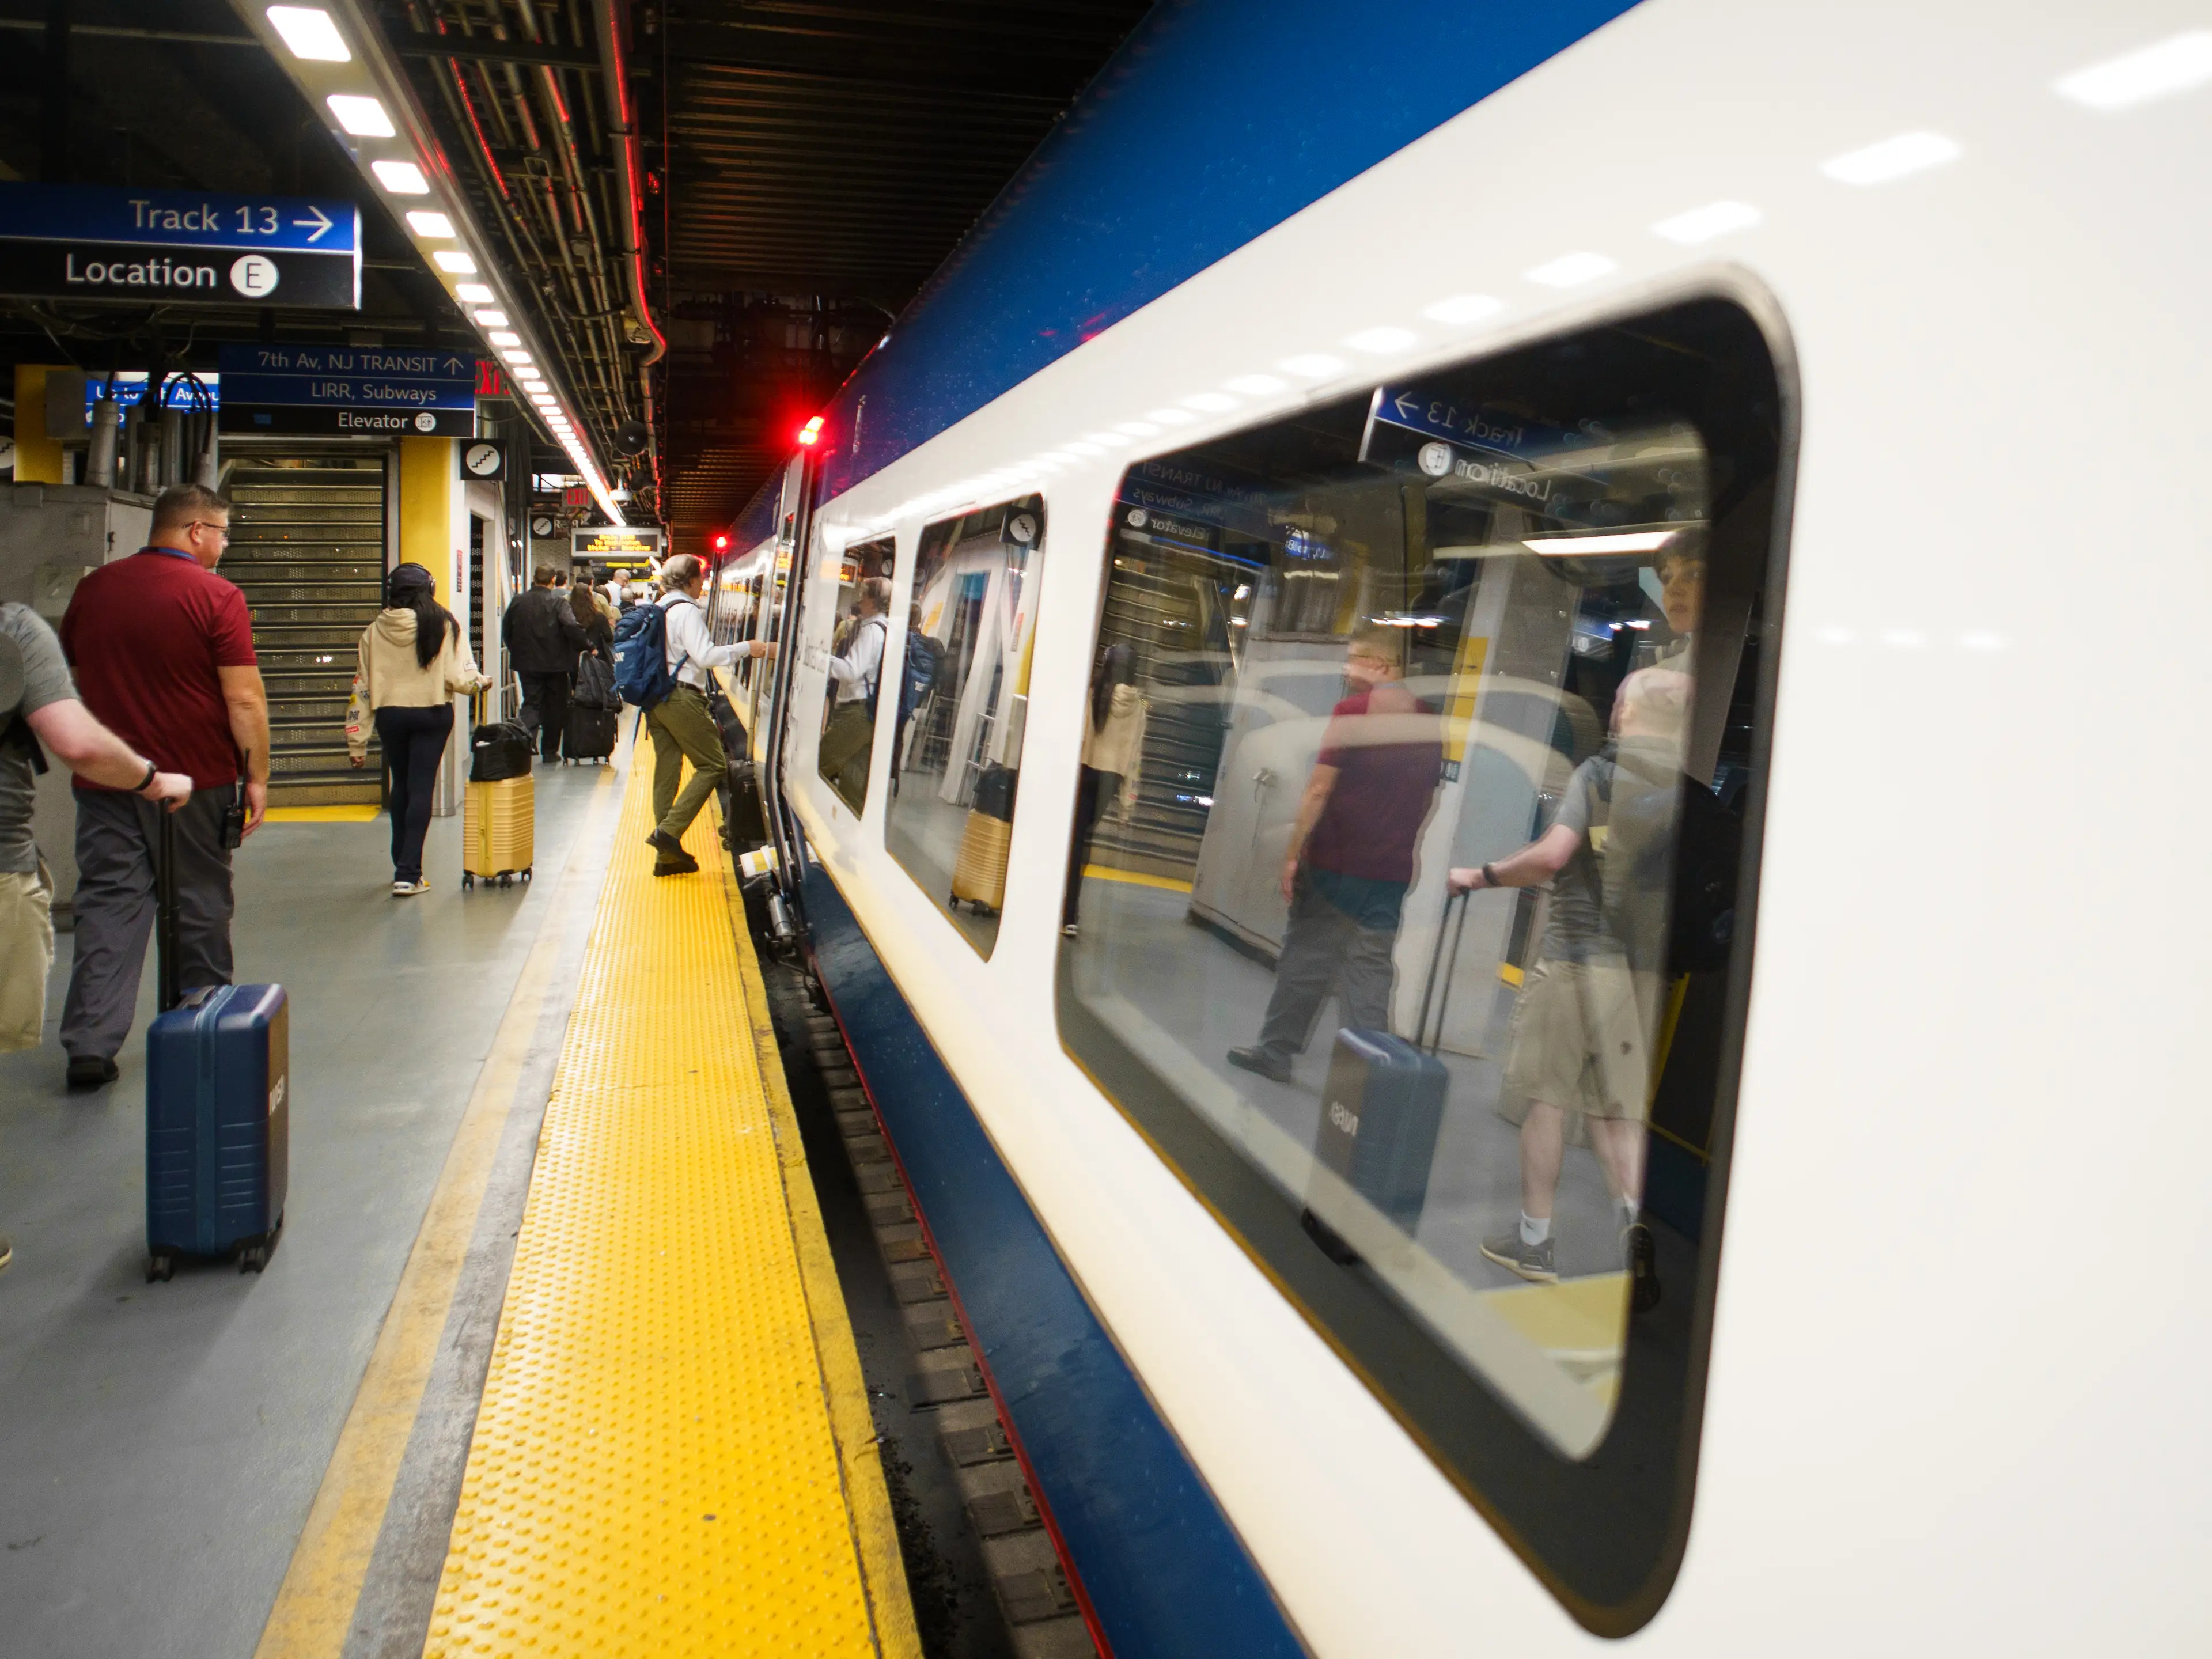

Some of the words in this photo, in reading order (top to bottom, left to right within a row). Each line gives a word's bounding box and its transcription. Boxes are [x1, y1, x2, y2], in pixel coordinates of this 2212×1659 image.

[128, 200, 219, 232] Track
[235, 206, 279, 234] 13
[66, 253, 217, 287] Location
[245, 262, 263, 289] E
[258, 351, 289, 368] 7th
[296, 353, 322, 370] Av,
[329, 354, 353, 370] NJ
[360, 355, 437, 373] TRANSIT
[312, 382, 355, 400] LIRR,
[363, 384, 437, 405] Subways
[338, 412, 409, 429] Elevator
[567, 488, 589, 505] EXIT
